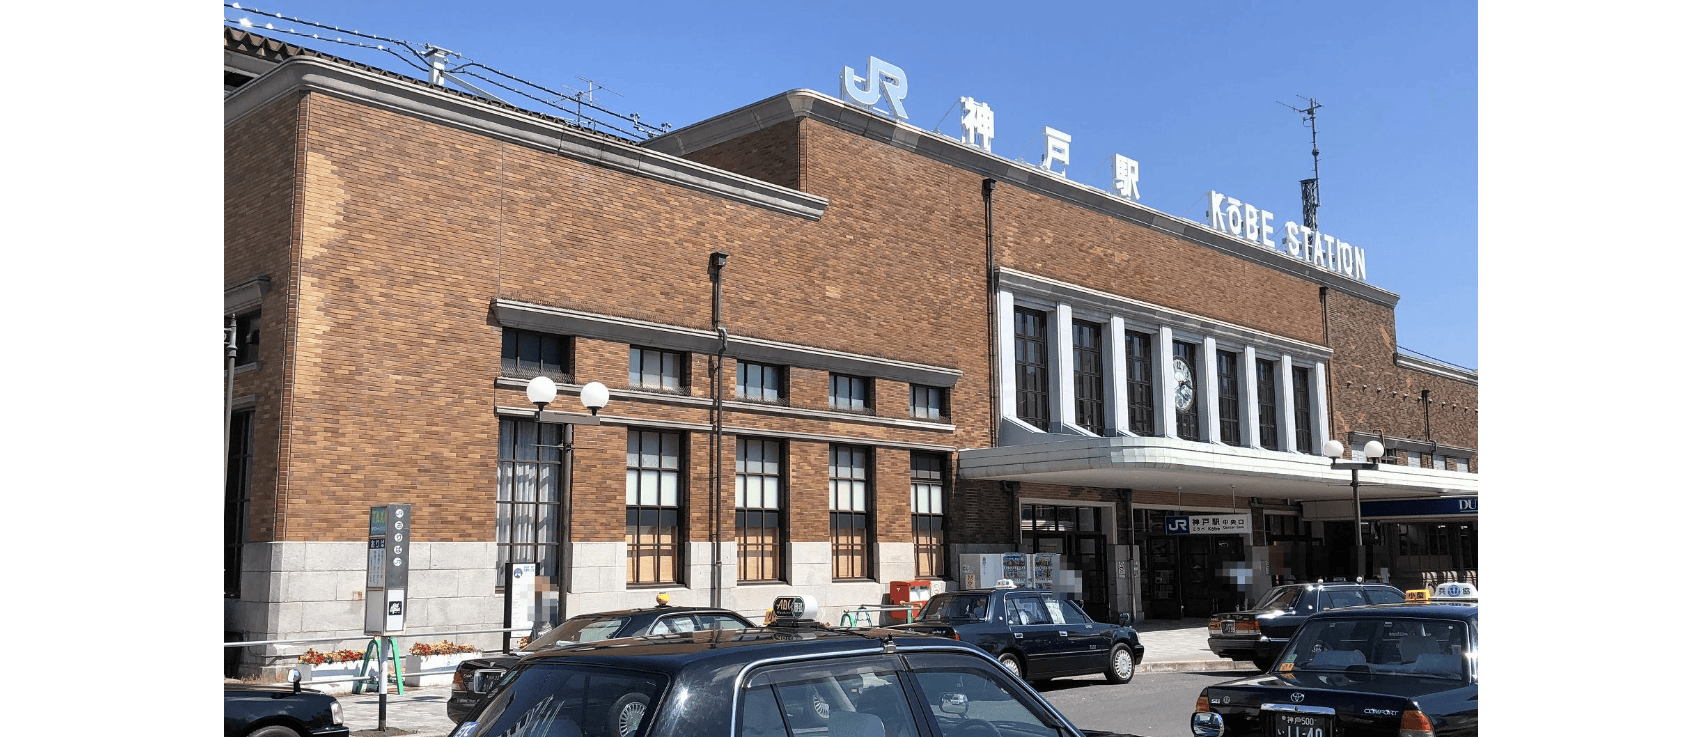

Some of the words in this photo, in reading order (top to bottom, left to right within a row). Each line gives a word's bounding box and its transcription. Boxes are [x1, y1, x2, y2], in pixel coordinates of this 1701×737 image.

[844, 55, 909, 119] JR
[1285, 221, 1366, 280] STATION
[1168, 519, 1187, 531] JR
[1363, 708, 1399, 716] COMFORT
